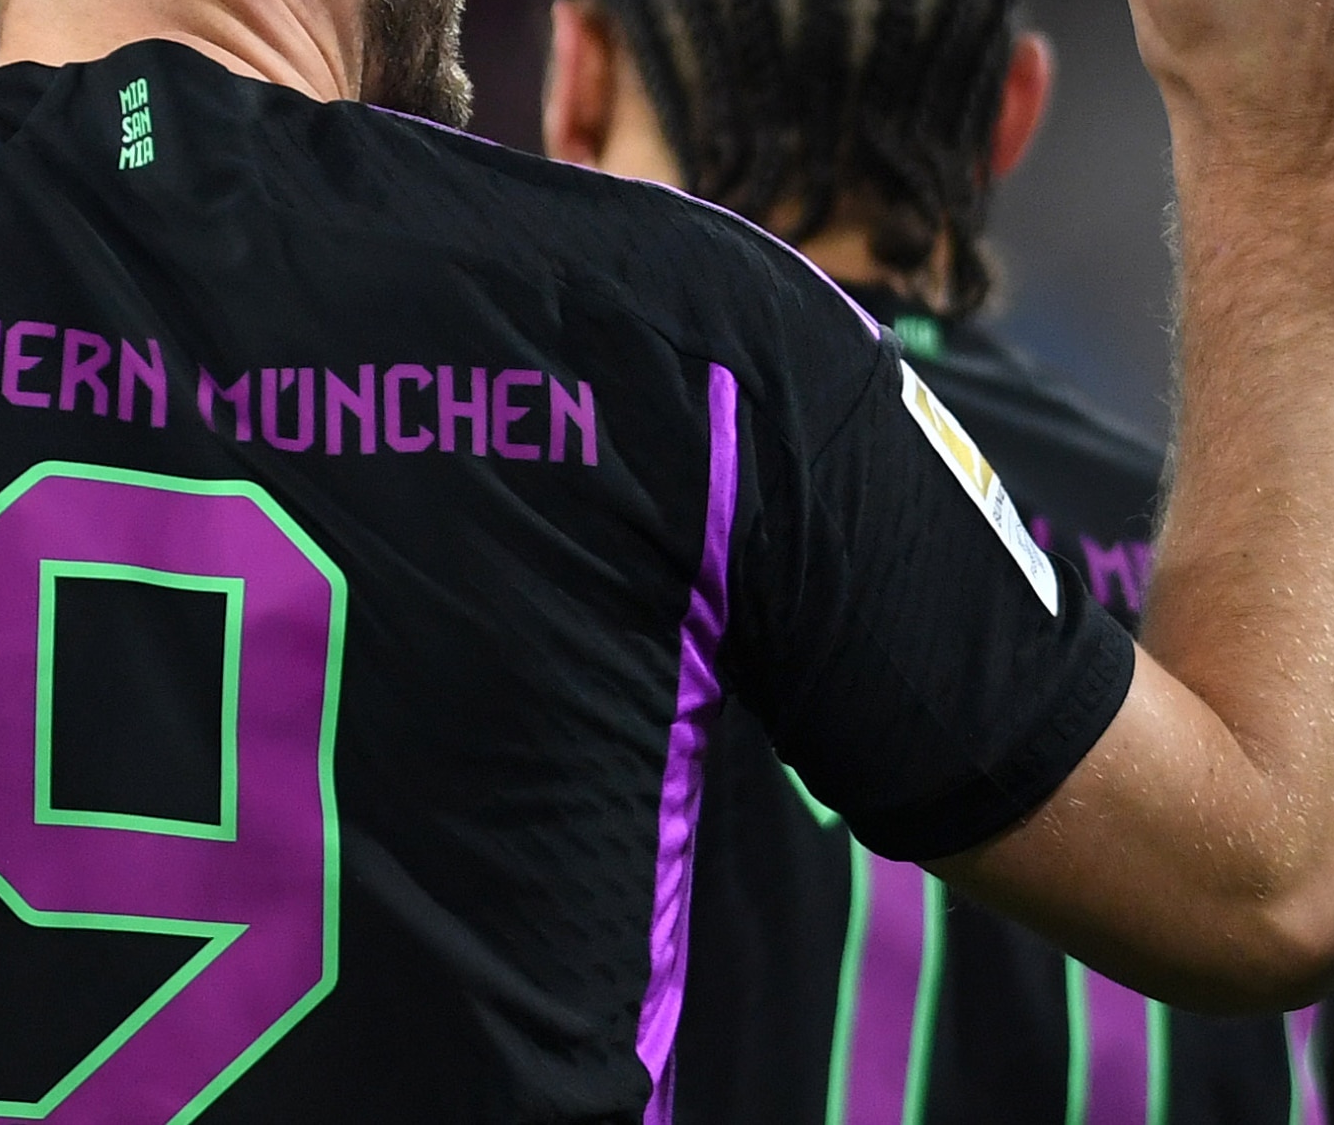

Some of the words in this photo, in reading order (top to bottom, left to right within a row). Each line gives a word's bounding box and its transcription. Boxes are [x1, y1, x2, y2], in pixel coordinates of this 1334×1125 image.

[118, 78, 149, 115] MIA
[121, 106, 153, 144] SAN
[118, 136, 155, 170] MIA
[195, 361, 600, 468] MÜNCHEN
